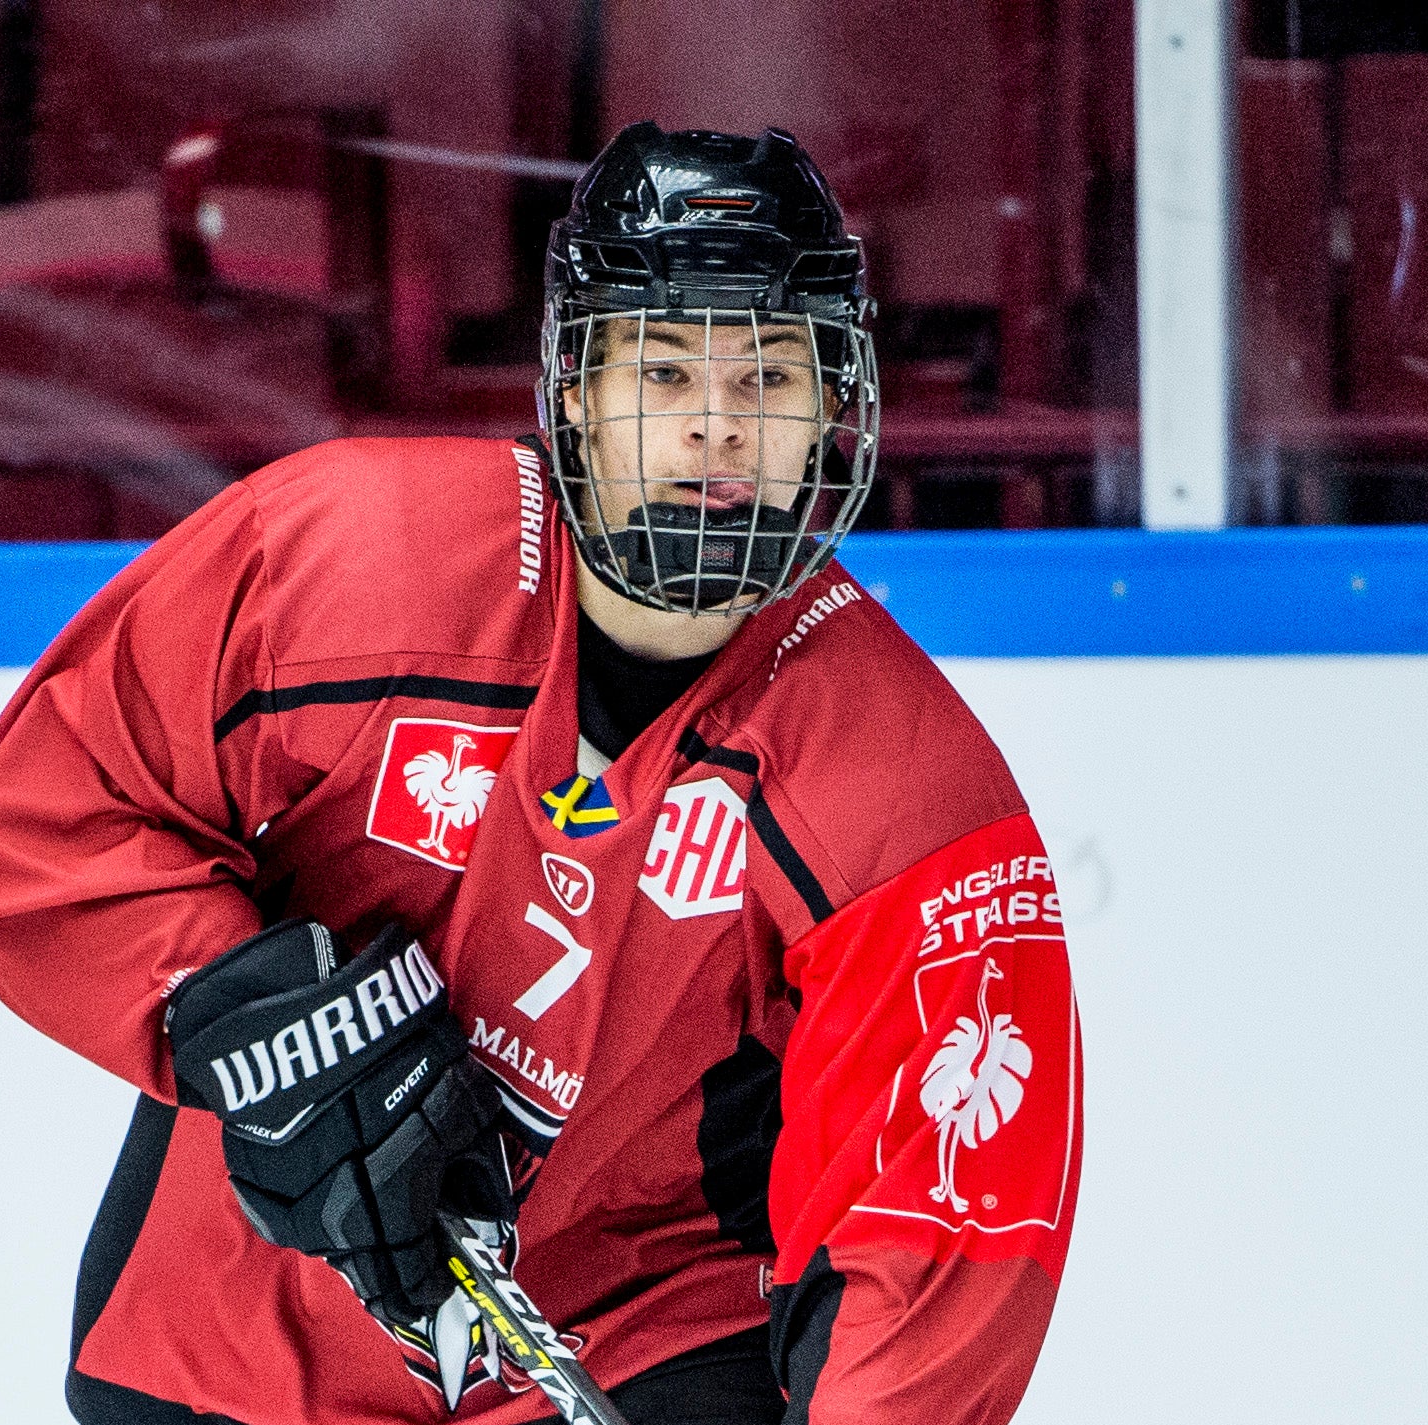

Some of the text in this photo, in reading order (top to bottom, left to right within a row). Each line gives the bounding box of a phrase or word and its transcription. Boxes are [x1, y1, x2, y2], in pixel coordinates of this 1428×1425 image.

[511, 447, 544, 596] WARRIOR
[769, 582, 862, 681] ARRIOR
[641, 796, 746, 903] CHL
[210, 939, 445, 1112] WARRIO
[468, 1016, 585, 1111] MALMÖ
[384, 1057, 428, 1111] COVERT
[448, 1256, 531, 1356] SUPER
[461, 1236, 577, 1361] CCM
